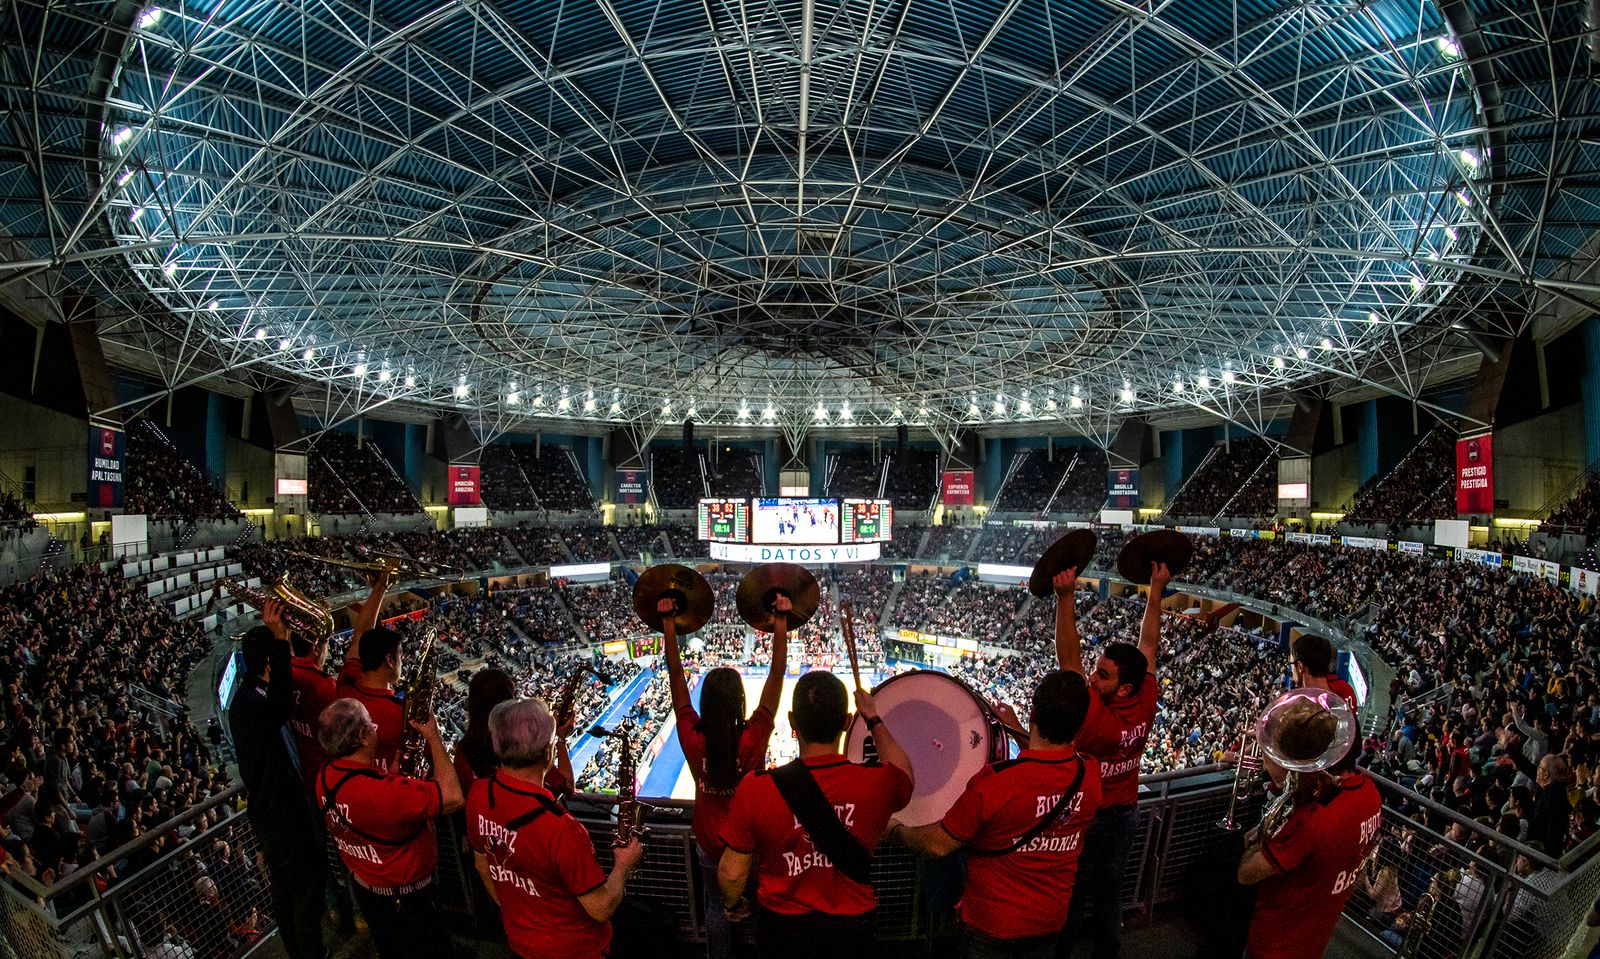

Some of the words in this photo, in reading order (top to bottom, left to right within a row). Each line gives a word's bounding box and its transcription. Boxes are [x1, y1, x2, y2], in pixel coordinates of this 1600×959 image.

[95, 457, 120, 470] HUMILDAD
[91, 470, 122, 483] APALTASUNA
[1461, 465, 1487, 478] PRESTIGIO
[870, 503, 880, 514] 52
[859, 524, 877, 534] 08:14
[761, 548, 822, 561] DATOS
[830, 548, 839, 560] Y
